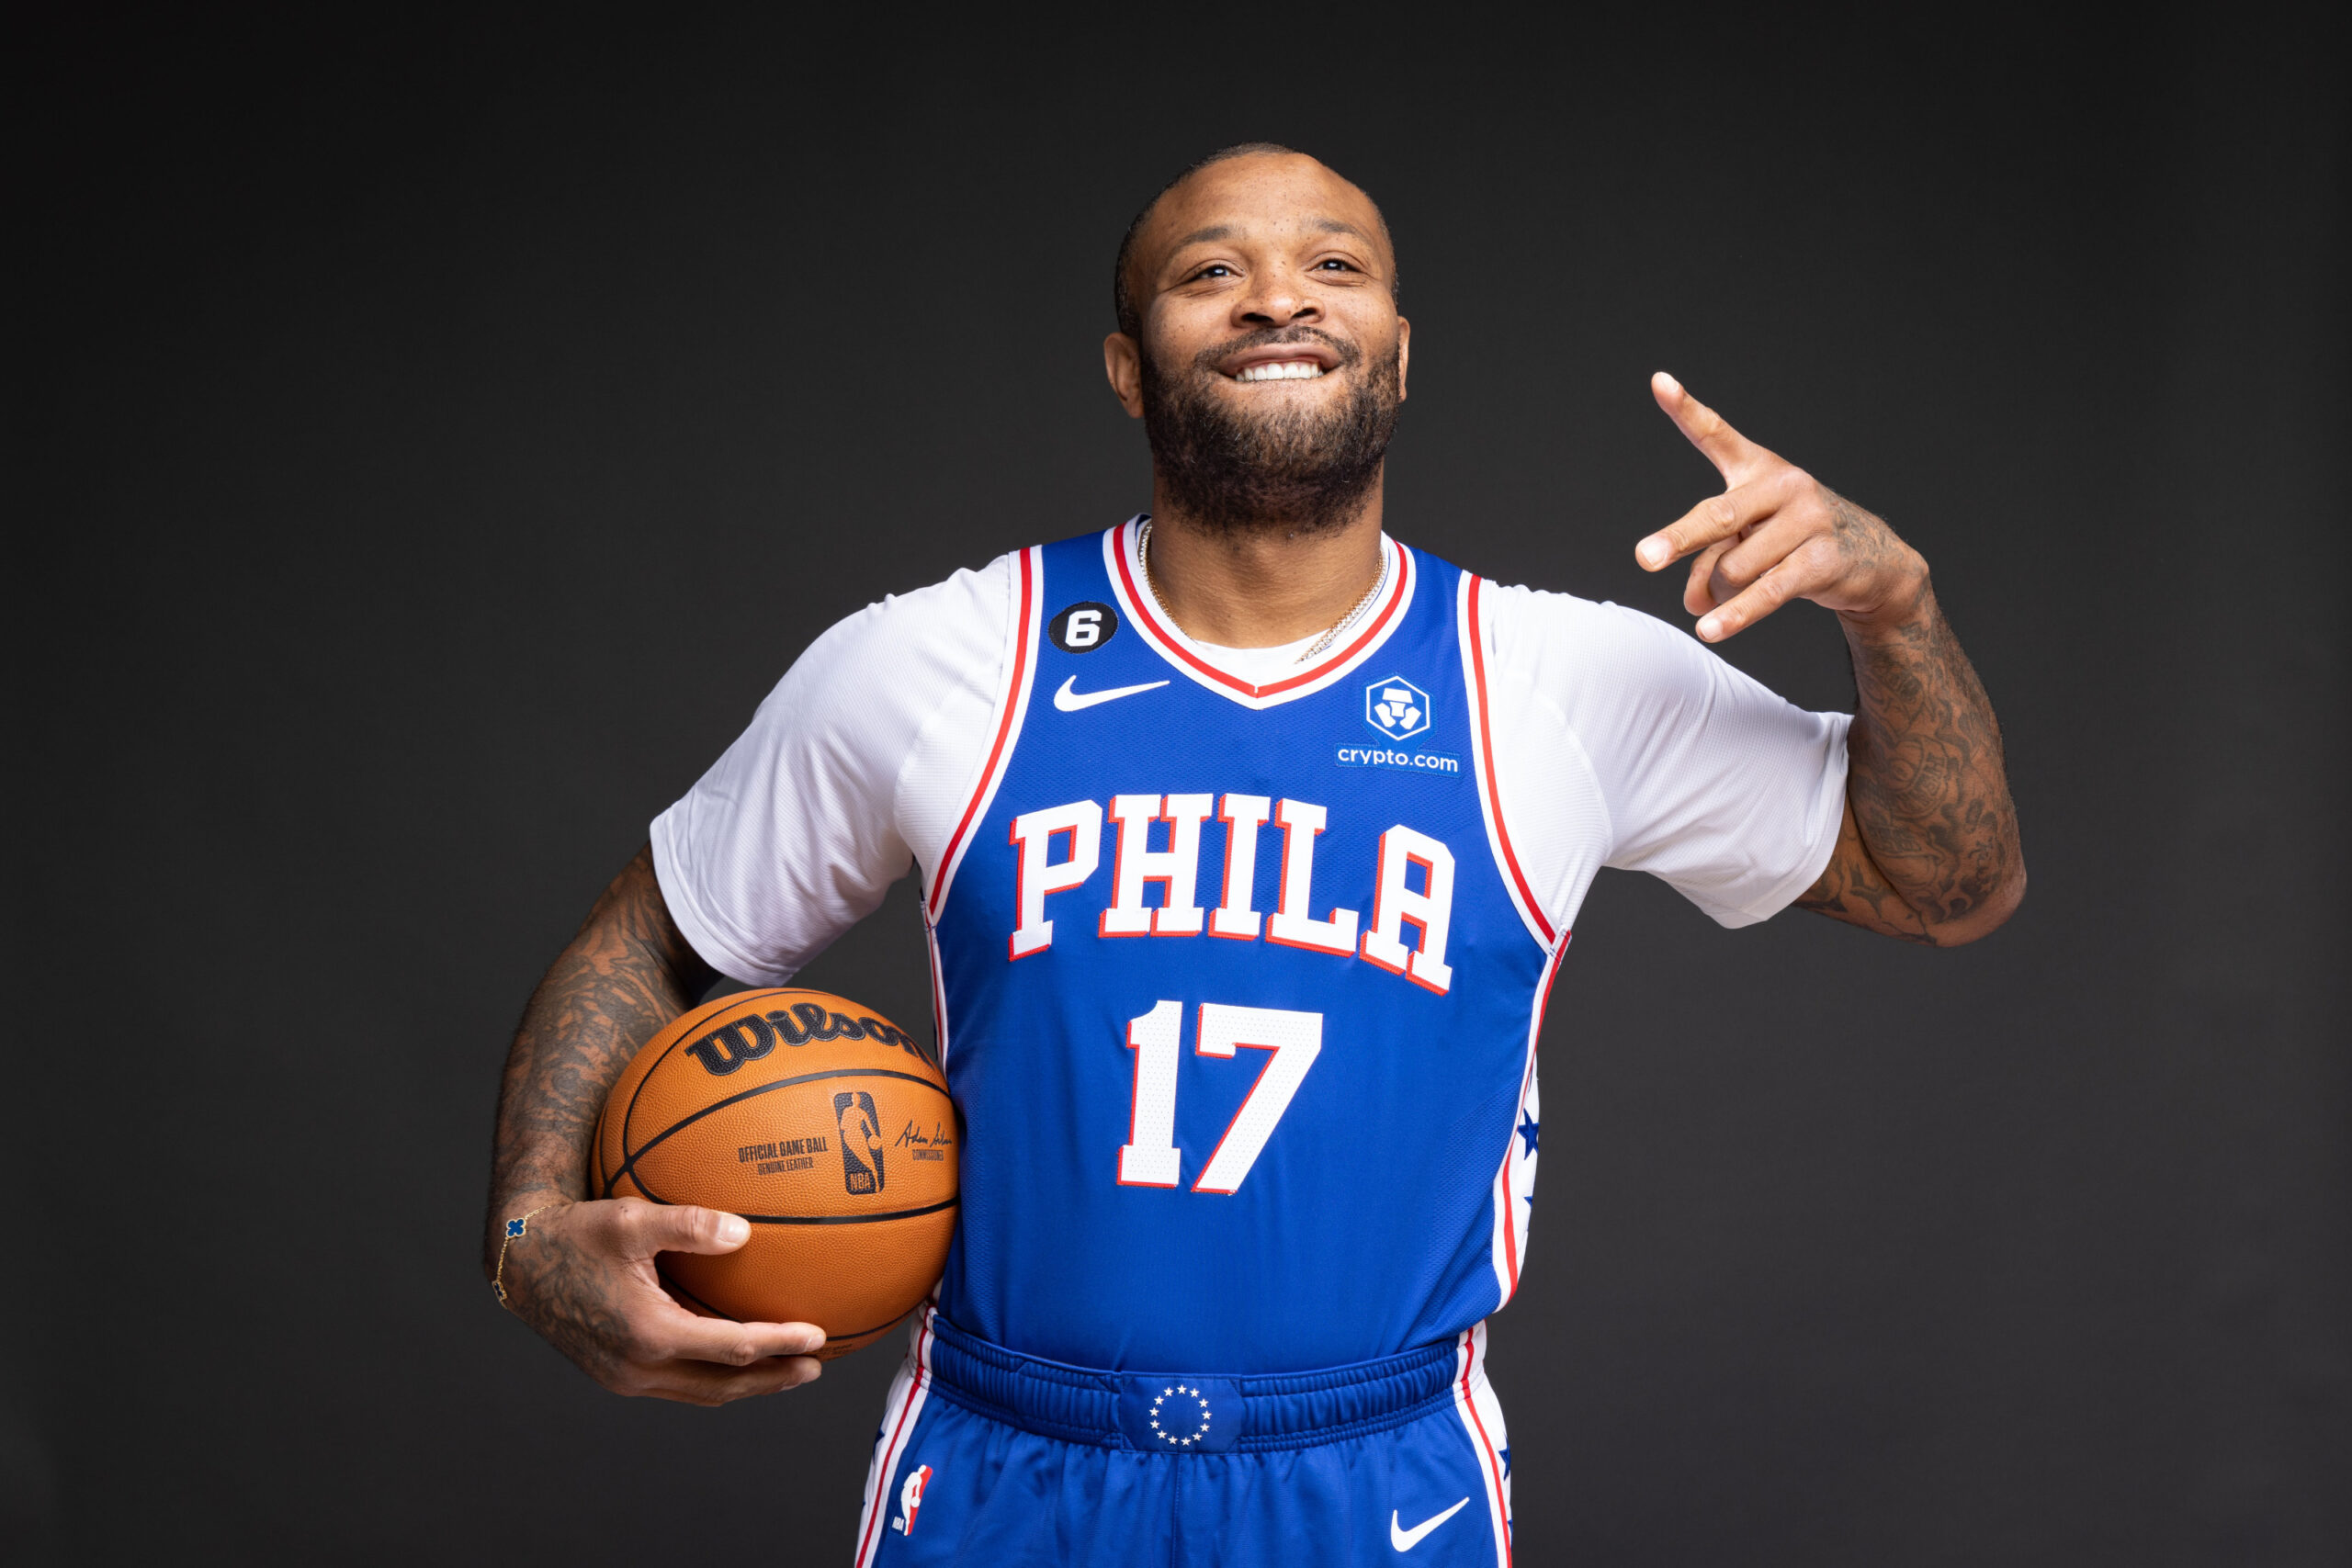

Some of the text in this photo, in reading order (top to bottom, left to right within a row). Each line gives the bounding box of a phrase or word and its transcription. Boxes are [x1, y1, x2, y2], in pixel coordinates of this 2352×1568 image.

[1065, 609, 1102, 647] 6
[1338, 749, 1458, 773] crypto.com
[1008, 793, 1456, 997] PHILA
[684, 1002, 935, 1077] Wilson
[1116, 998, 1324, 1195] 17
[738, 1136, 828, 1163] OFFICIAL GAME BALL
[757, 1156, 814, 1176] GENUINE LEATHER
[849, 1171, 872, 1190] NBA
